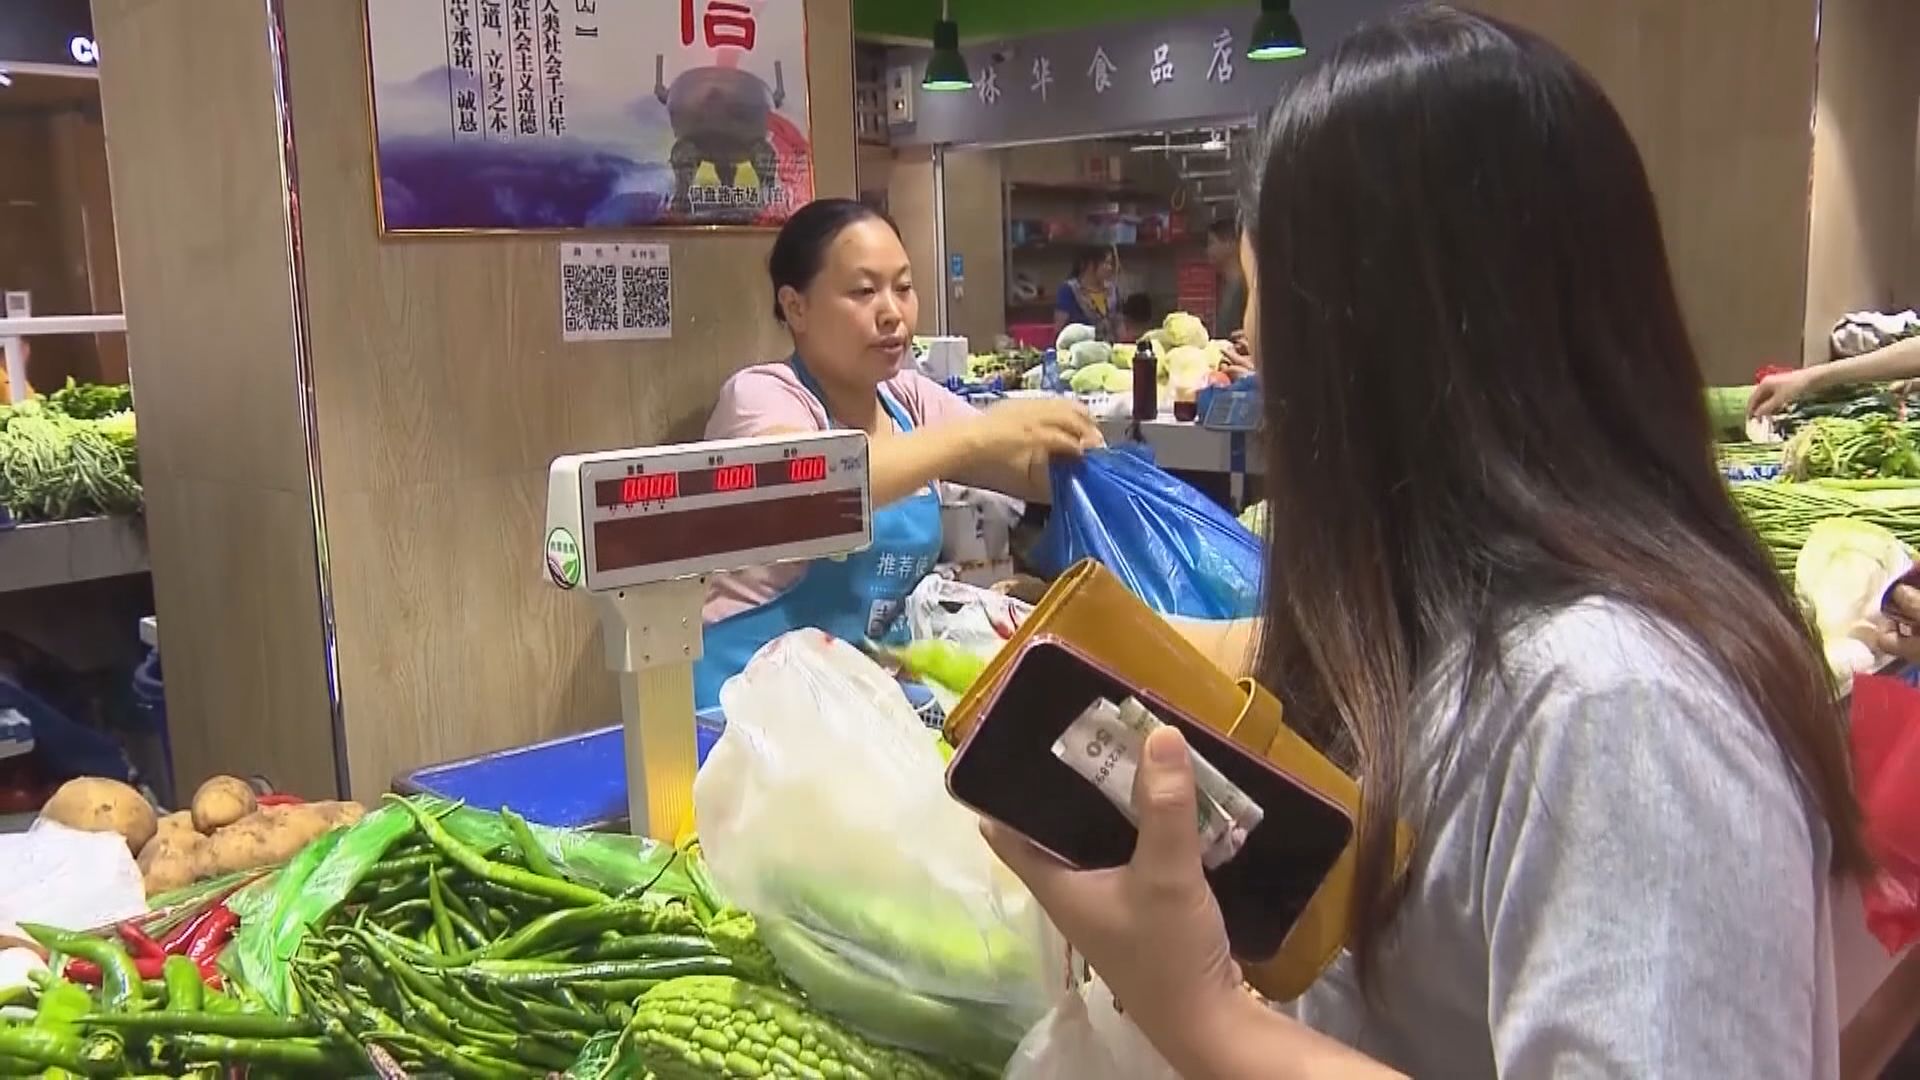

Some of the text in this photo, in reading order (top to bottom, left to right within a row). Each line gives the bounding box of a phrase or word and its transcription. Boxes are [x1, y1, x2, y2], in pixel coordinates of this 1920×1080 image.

[449, 0, 478, 133] 守承诺，诚恳
[1086, 727, 1112, 758] 50
